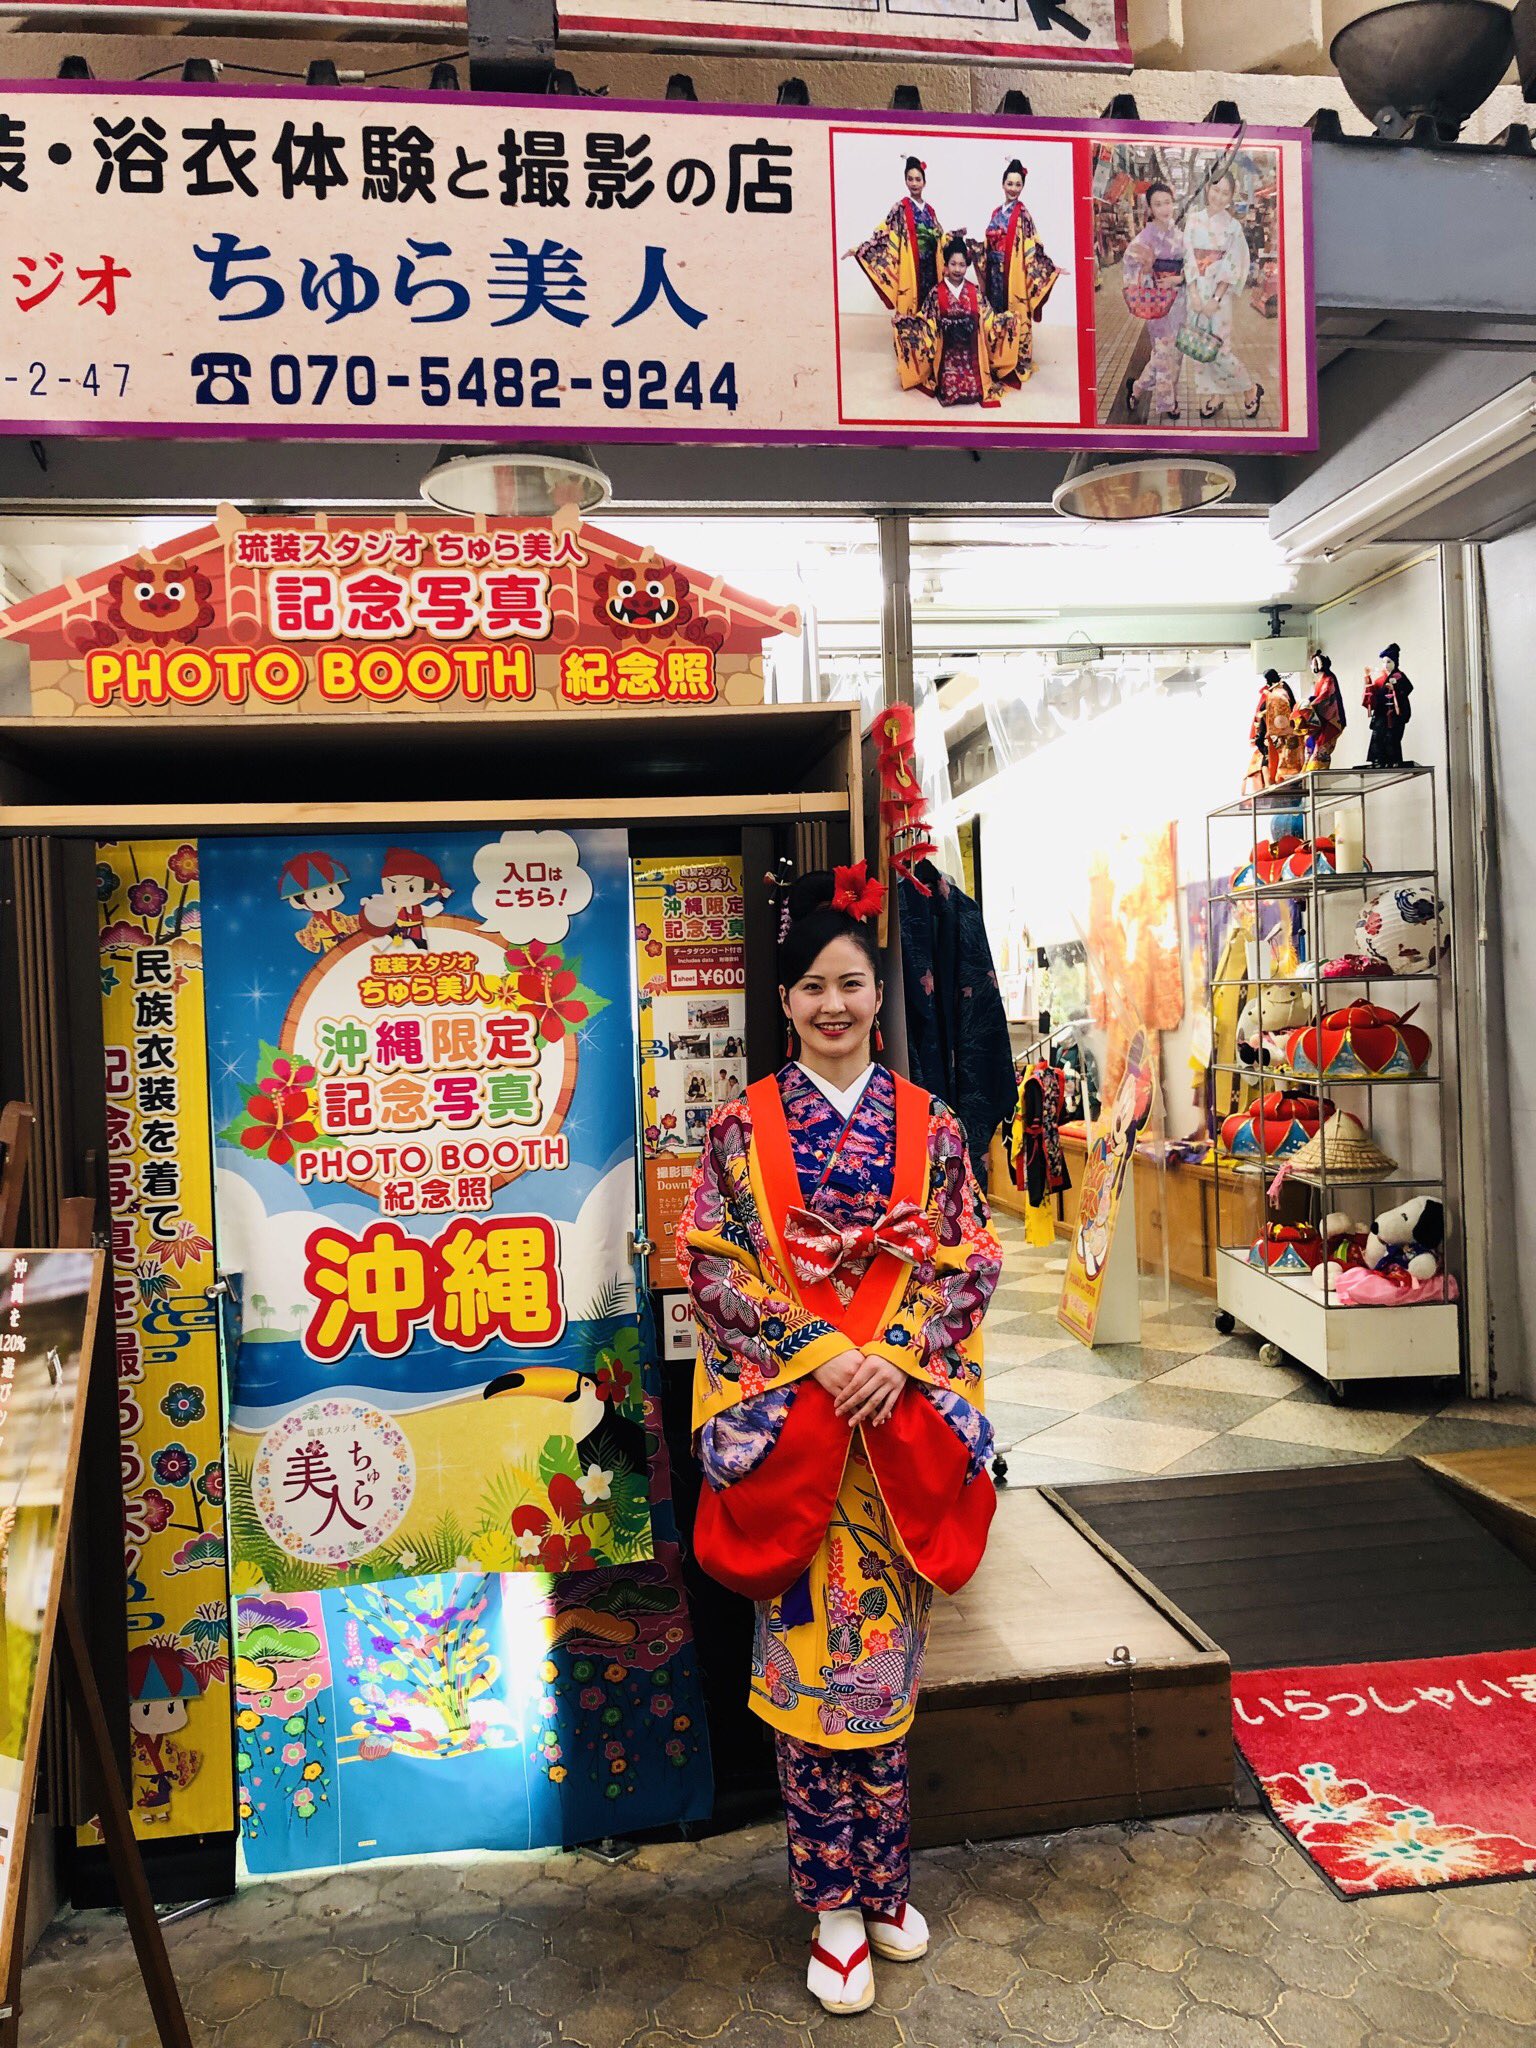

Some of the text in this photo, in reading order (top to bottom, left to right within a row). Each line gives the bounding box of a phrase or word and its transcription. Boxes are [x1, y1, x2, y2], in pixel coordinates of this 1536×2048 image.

[12, 232, 709, 330] ジオ ちゅら美人
[270, 353, 739, 411] 070-5482-9244
[238, 532, 584, 564] 琉装スタジオ ちゅら美人
[275, 574, 543, 631] 記念写真
[90, 648, 529, 700] PHOTO BOOTH
[564, 650, 712, 697] 紀念照
[502, 862, 563, 883] 入口は
[674, 877, 737, 892] ちゅら美人
[495, 887, 568, 908] こちら!
[663, 896, 744, 916] 沖縄限定
[664, 919, 744, 939] 記念写真
[373, 953, 476, 974] 琉装スタジオ
[698, 968, 745, 986] ¥600
[359, 974, 493, 1004] ちゅら美人
[321, 1014, 534, 1068] 沖縄限定
[133, 948, 179, 1237] 民族衣装を着て
[323, 1072, 533, 1128] 記念写真
[299, 1138, 566, 1180] PHOTO BOOTH
[383, 1178, 491, 1211] 紀念照
[312, 1224, 556, 1350] 沖縄
[282, 1440, 367, 1537] 美人
[348, 1440, 380, 1512] ちゅら
